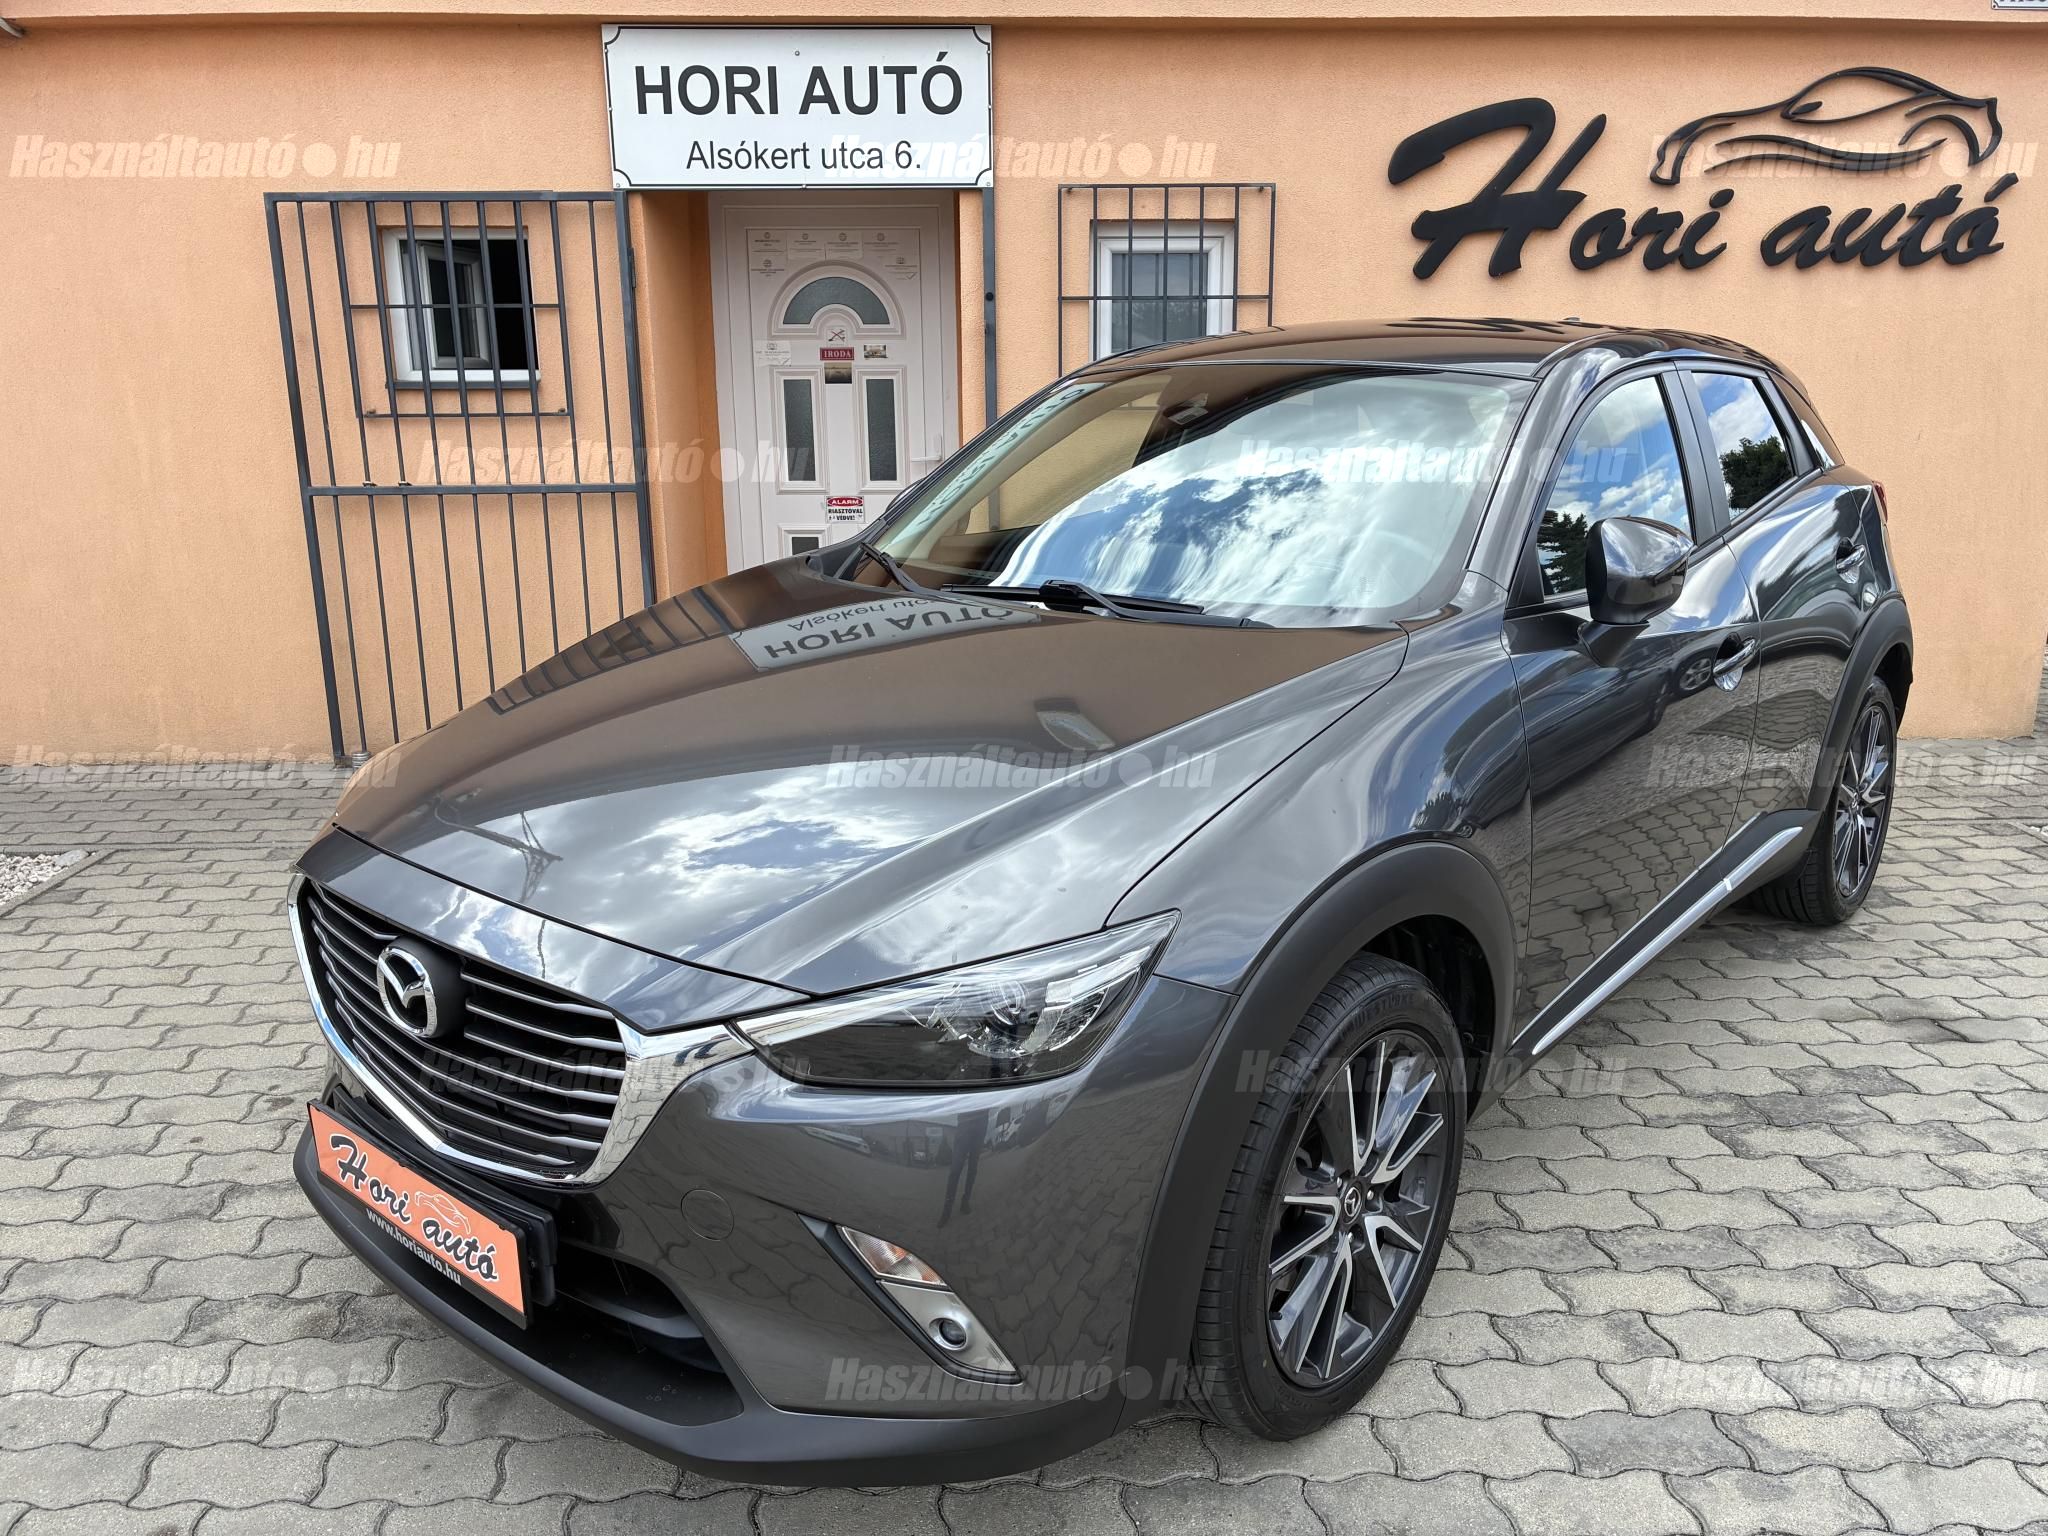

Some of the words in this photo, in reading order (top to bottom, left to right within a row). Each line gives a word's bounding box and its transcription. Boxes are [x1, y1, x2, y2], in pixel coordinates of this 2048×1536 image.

[634, 65, 778, 116] HORI
[798, 52, 963, 115] AUTÓ
[686, 139, 811, 170] Alsókert
[821, 143, 884, 169] utca
[894, 140, 921, 169] 6.
[1388, 97, 1735, 279] Hori
[1760, 173, 2018, 269] autó
[823, 349, 852, 358] IRODA
[330, 1133, 412, 1223] Hori
[422, 1217, 499, 1282] autó
[366, 1208, 462, 1286] www.horiauto.hu
